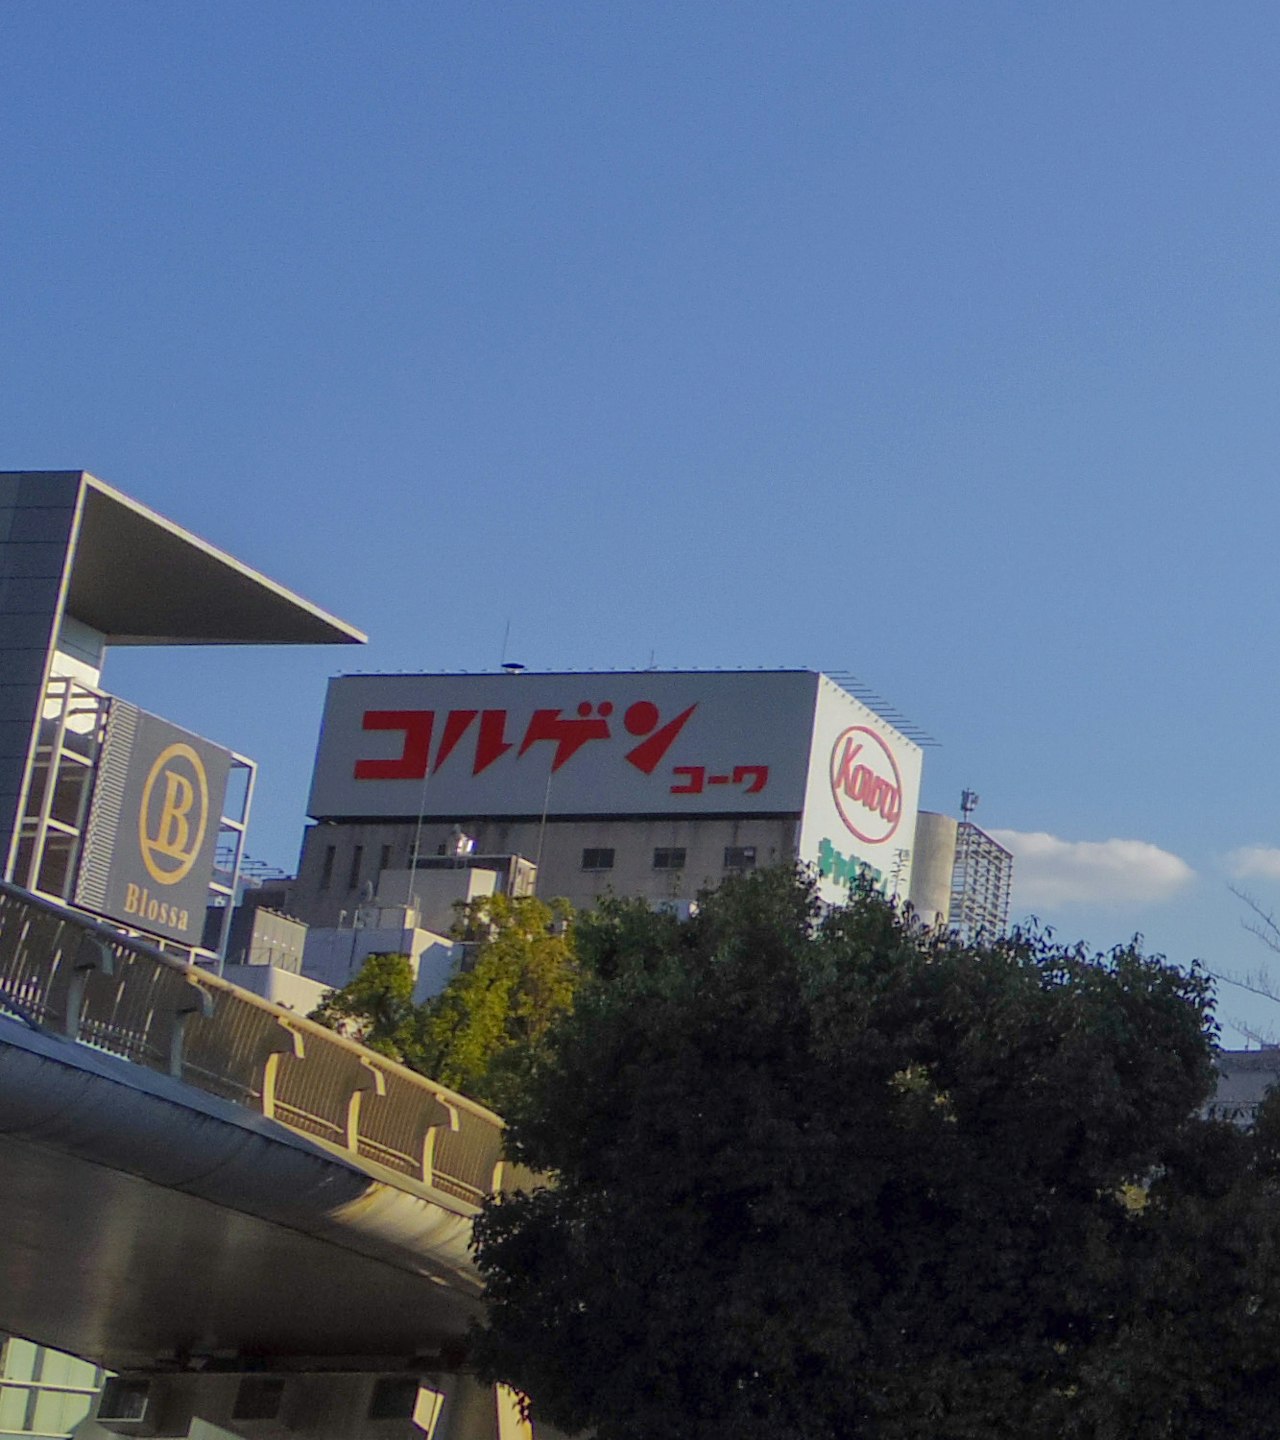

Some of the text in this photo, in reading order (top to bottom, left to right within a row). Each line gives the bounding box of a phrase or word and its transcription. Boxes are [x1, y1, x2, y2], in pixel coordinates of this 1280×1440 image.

[353, 701, 698, 779] コルゲン
[670, 765, 769, 793] コーワ
[835, 736, 900, 824] Kowa
[123, 883, 189, 931] Blossa
